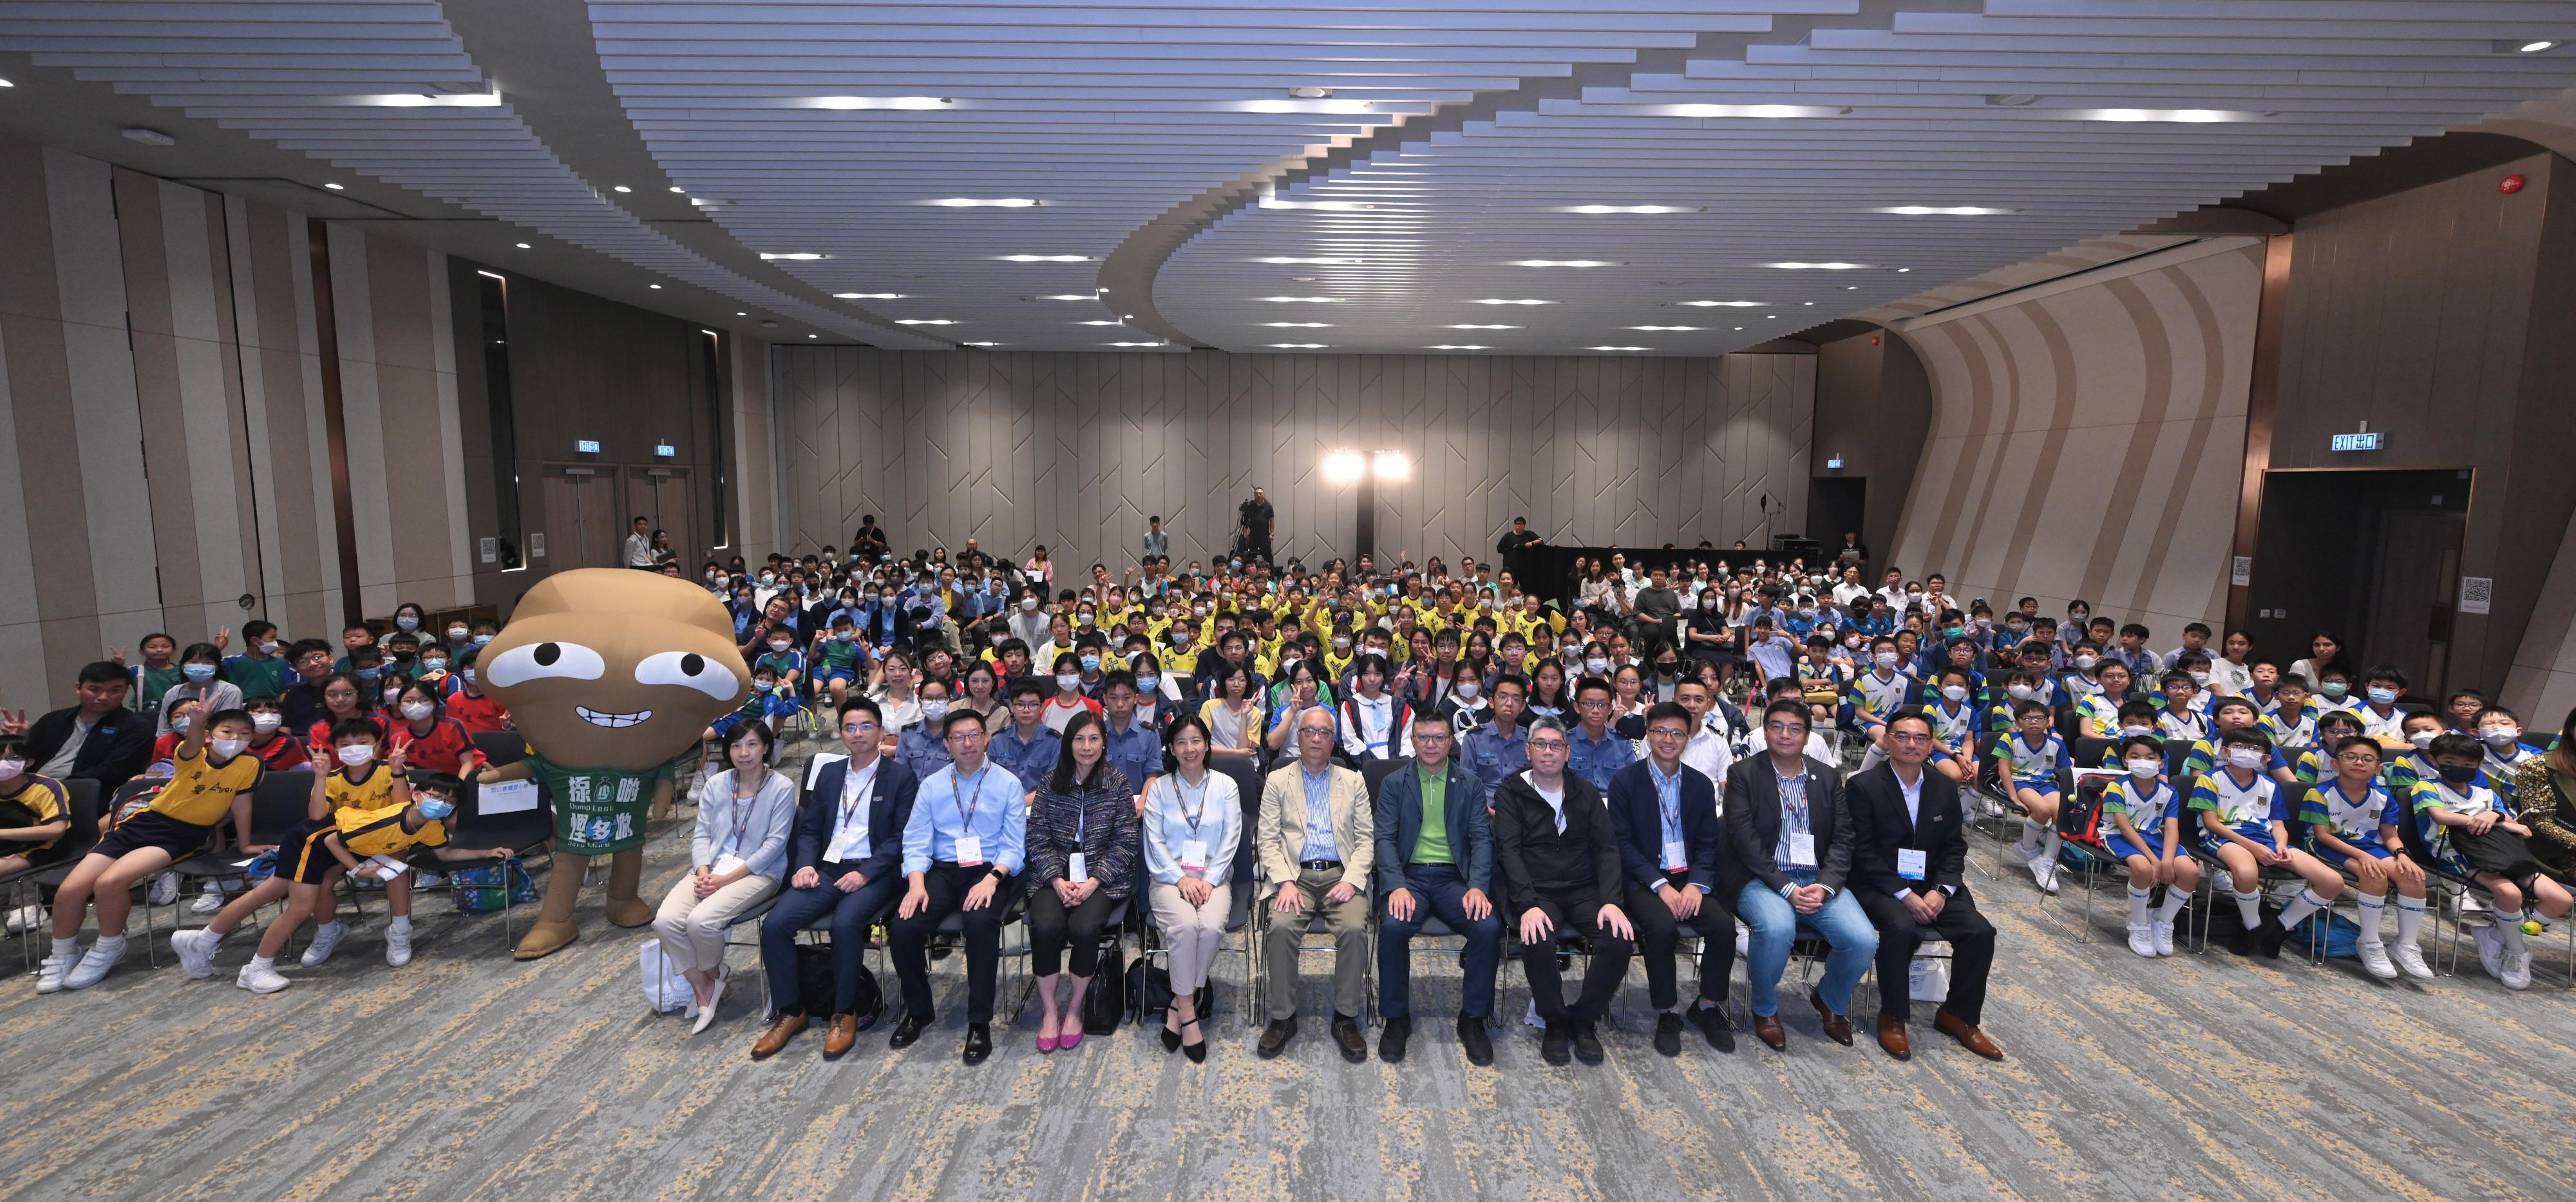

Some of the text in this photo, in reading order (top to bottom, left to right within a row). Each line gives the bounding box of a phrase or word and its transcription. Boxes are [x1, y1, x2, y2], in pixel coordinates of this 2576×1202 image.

[581, 442, 589, 451] EXIT
[2334, 435, 2374, 450] EXIT 出口
[570, 803, 591, 811] Dump
